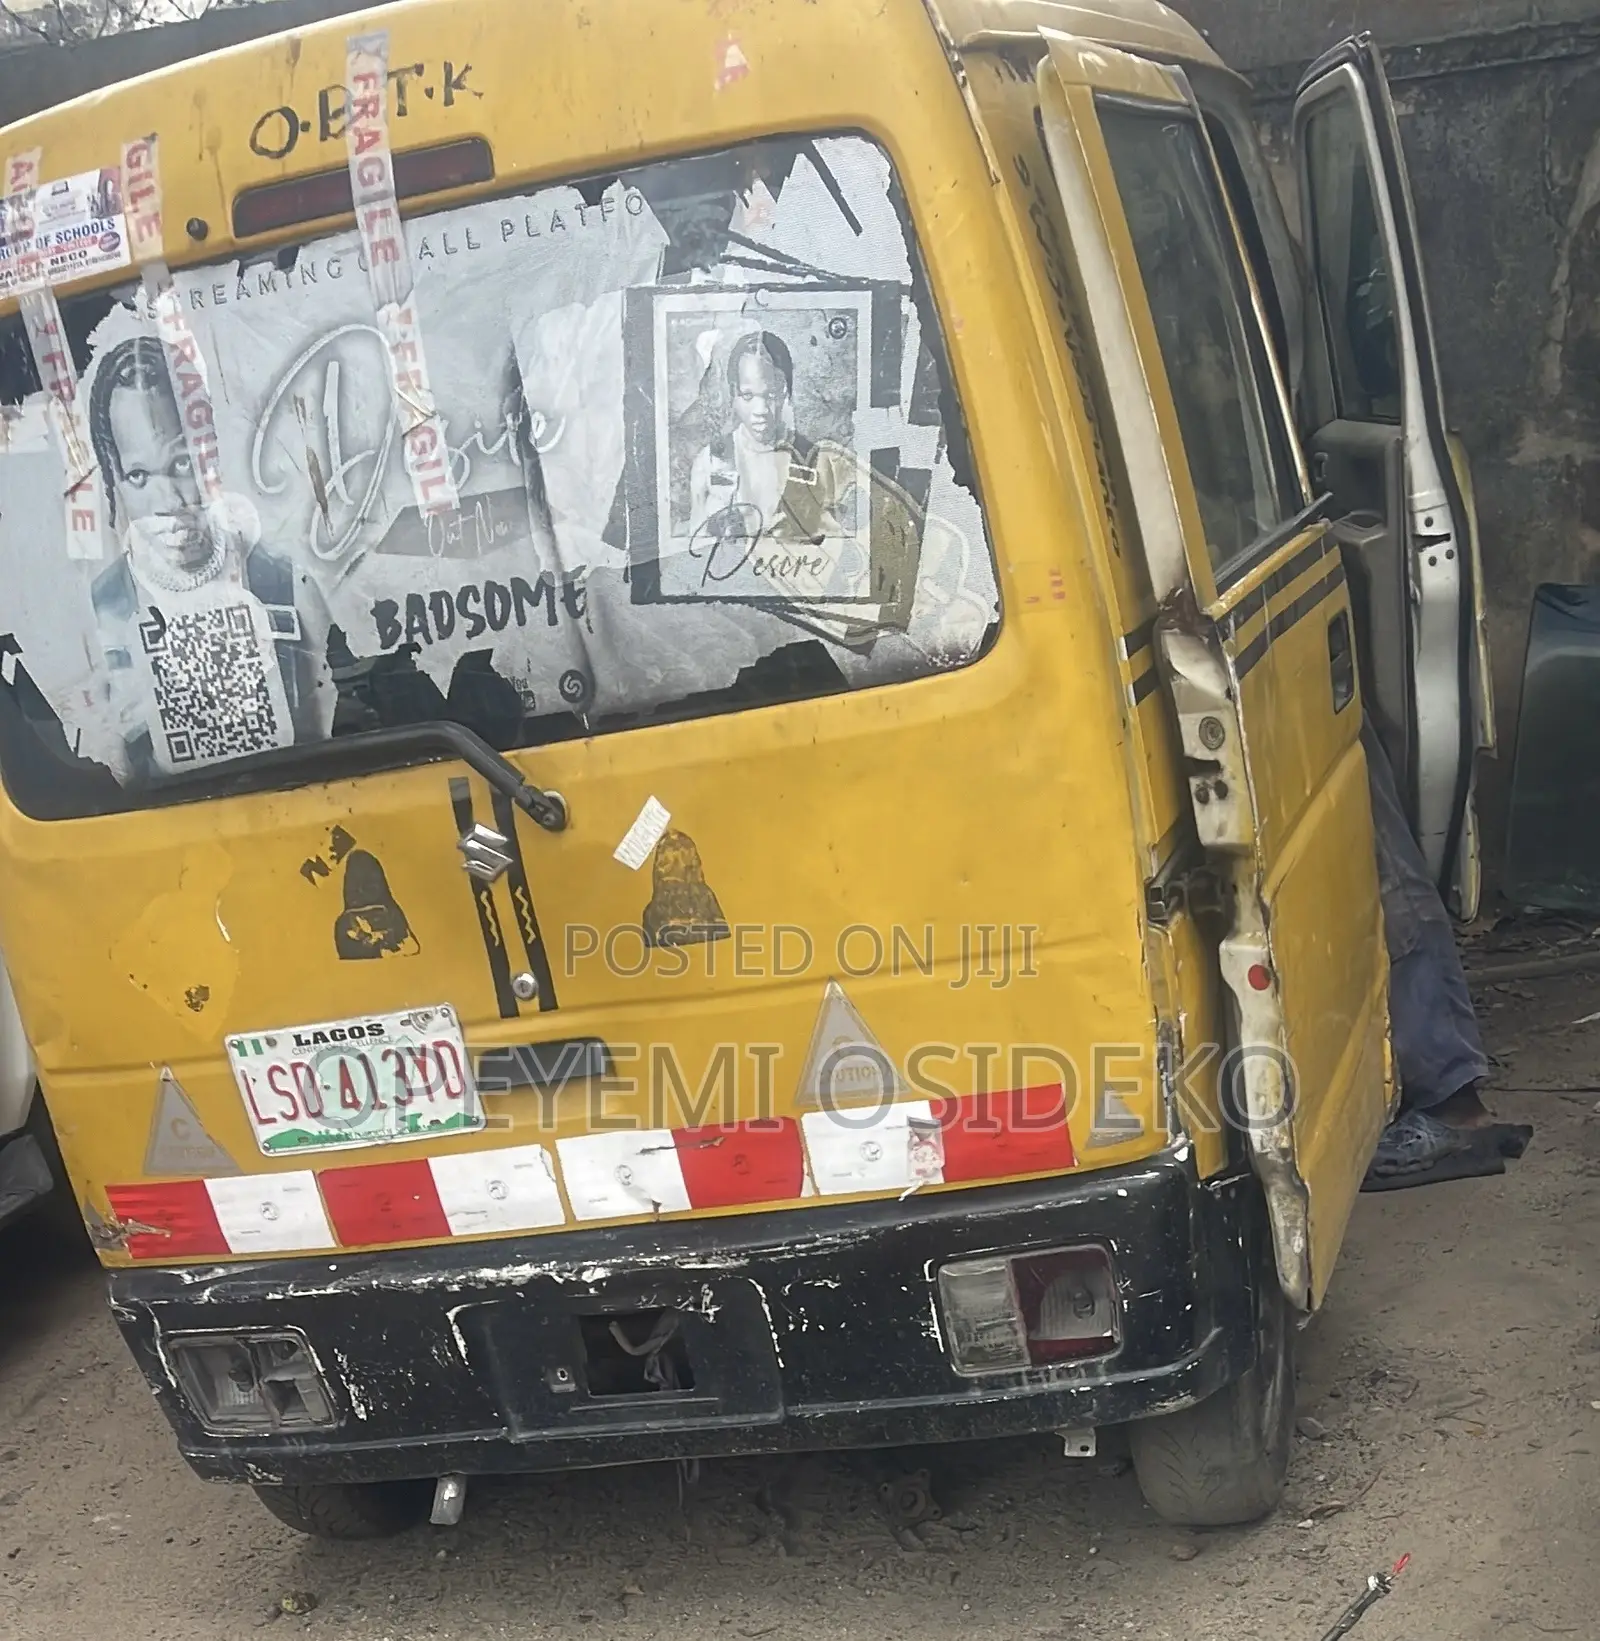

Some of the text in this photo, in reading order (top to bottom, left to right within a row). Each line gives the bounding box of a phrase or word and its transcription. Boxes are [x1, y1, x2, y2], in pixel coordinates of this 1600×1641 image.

[353, 72, 400, 268] FRAGILE
[55, 217, 116, 245] SCHOOLS
[418, 226, 481, 261] ALL
[369, 565, 589, 650] BADSOME
[292, 1022, 385, 1048] LAGOS
